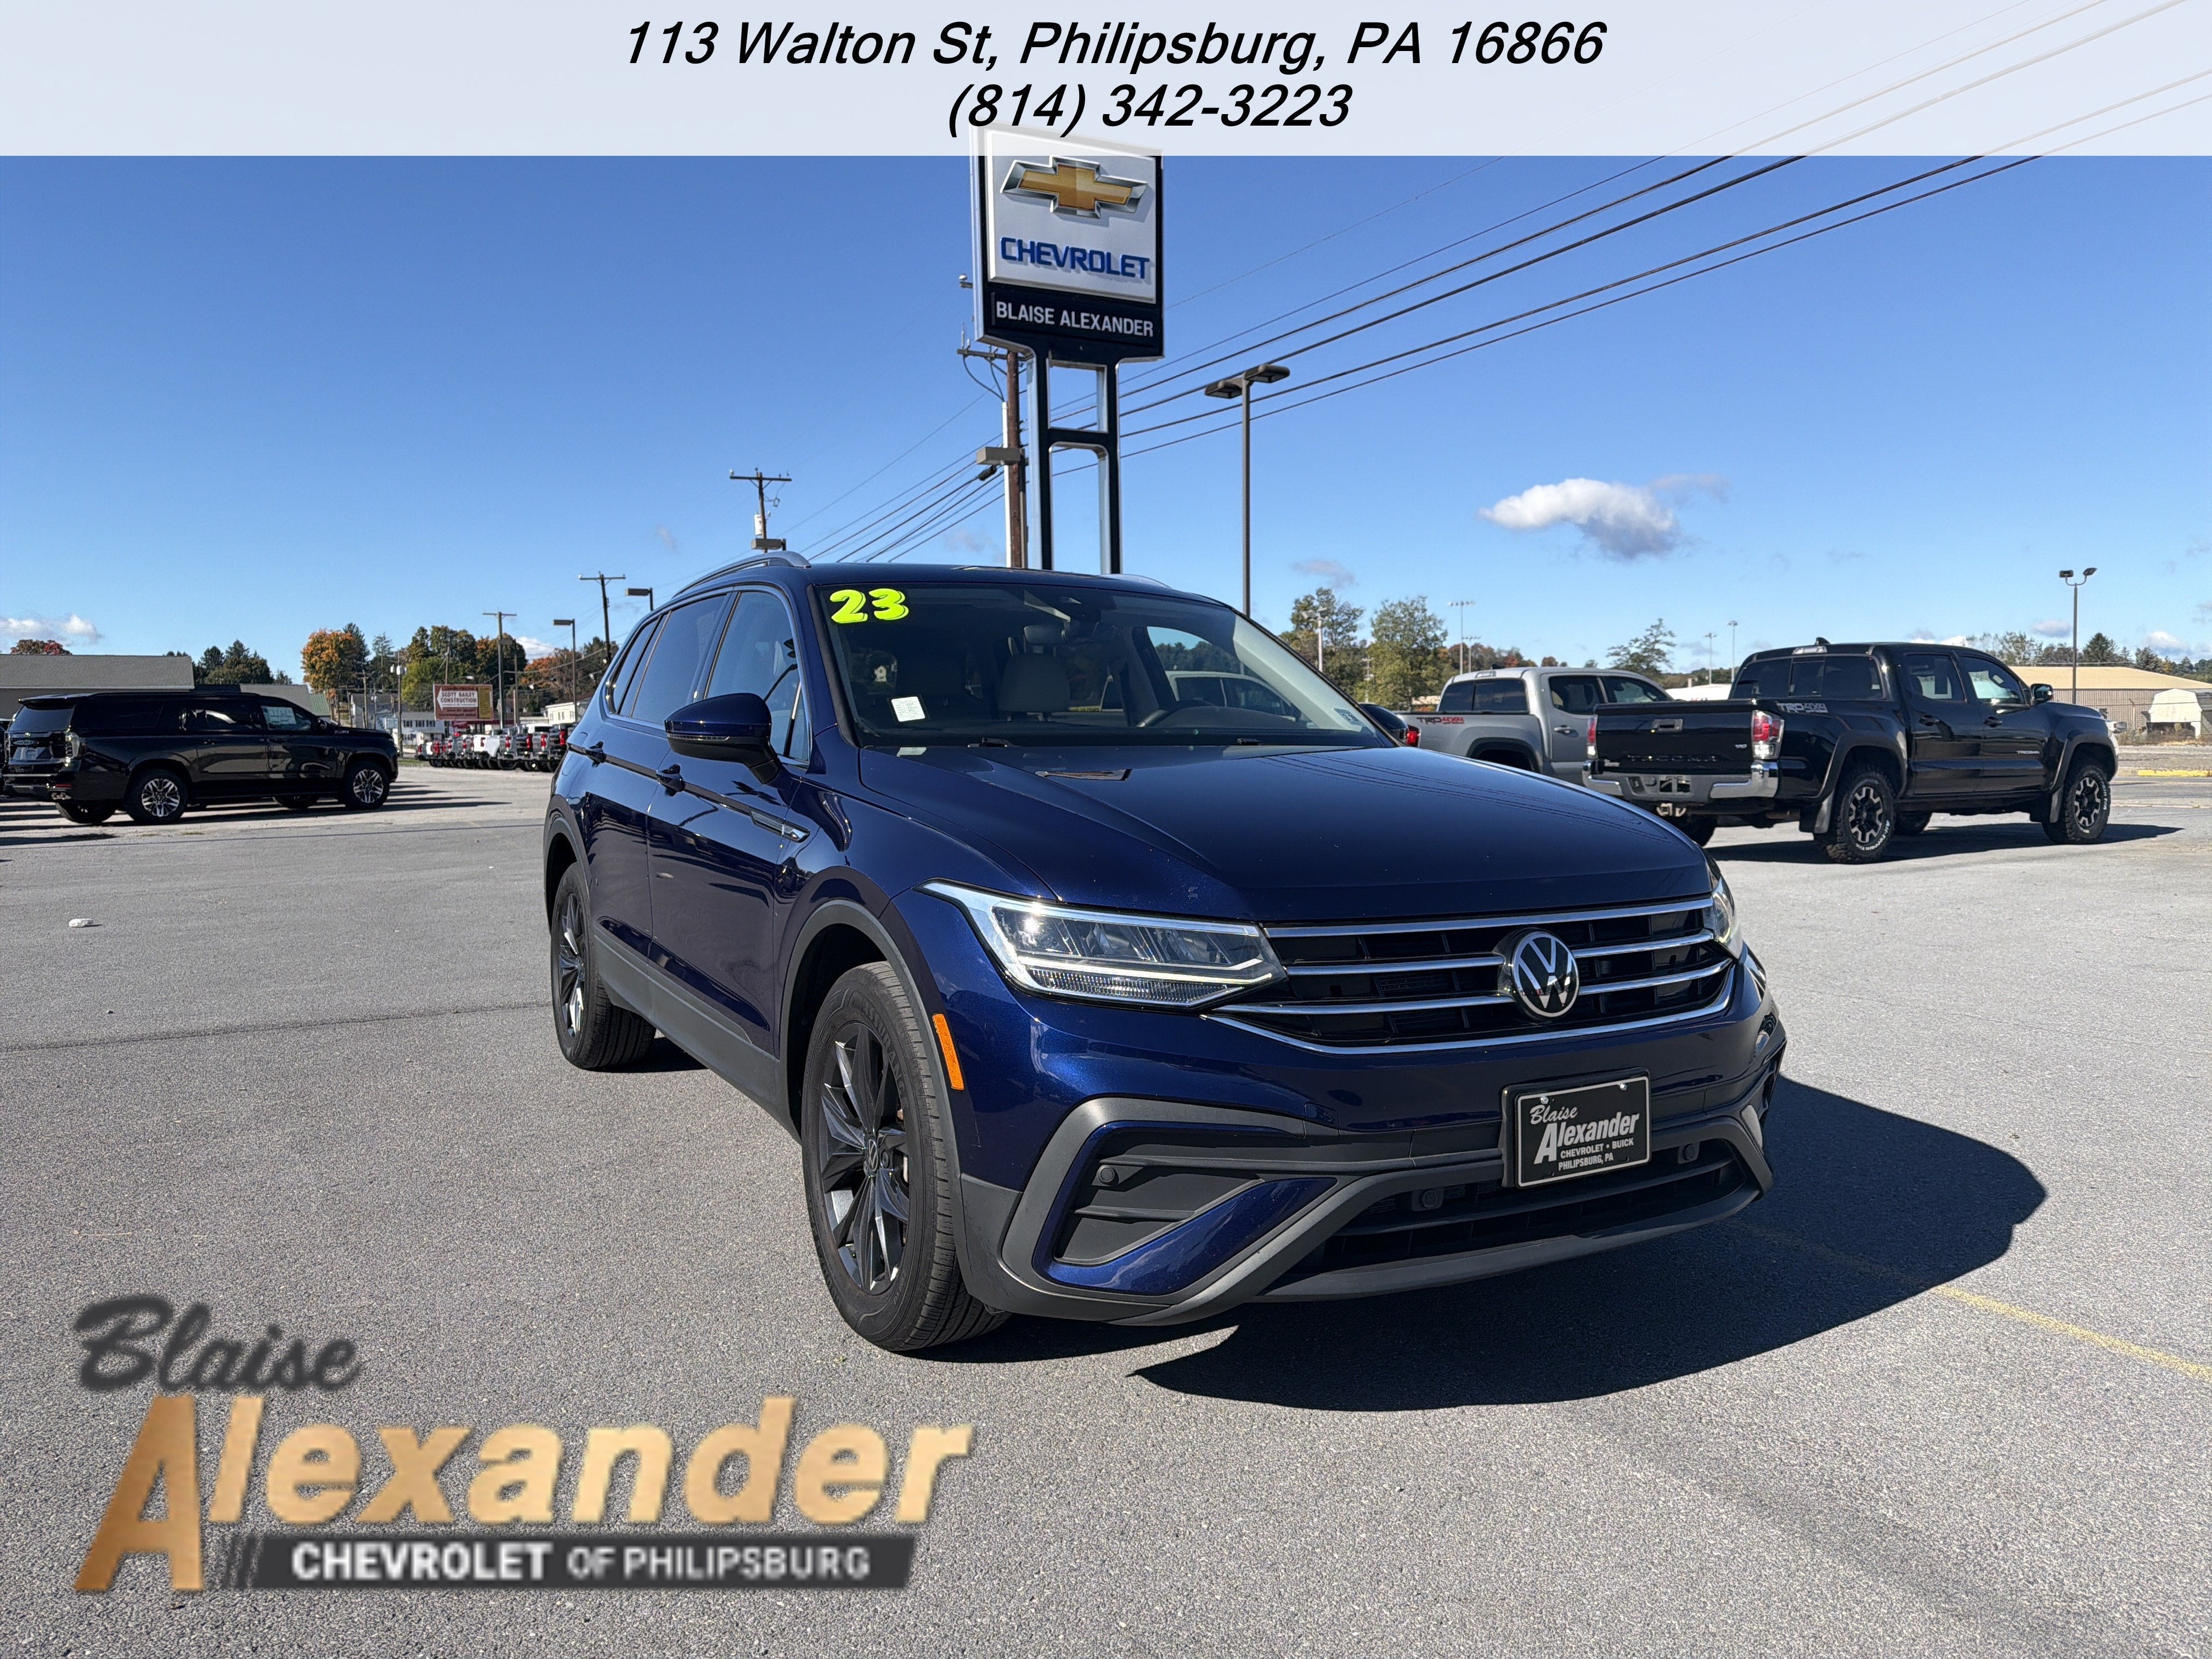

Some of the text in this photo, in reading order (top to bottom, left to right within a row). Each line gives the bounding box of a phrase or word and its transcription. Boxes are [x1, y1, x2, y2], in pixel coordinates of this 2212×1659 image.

[1001, 237, 1150, 279] CHEVROLET
[996, 301, 1153, 337] BLAISE ALEXANDER
[830, 588, 909, 624] 23
[1776, 703, 1804, 713] TRD
[1417, 716, 1441, 725] TRD
[1530, 1104, 1578, 1125] Blaise
[1533, 1111, 1640, 1165] Alexander
[1560, 1137, 1634, 1159] CHEVROLET BUICK
[1558, 1152, 1613, 1171] PHILIPSBURG, PA
